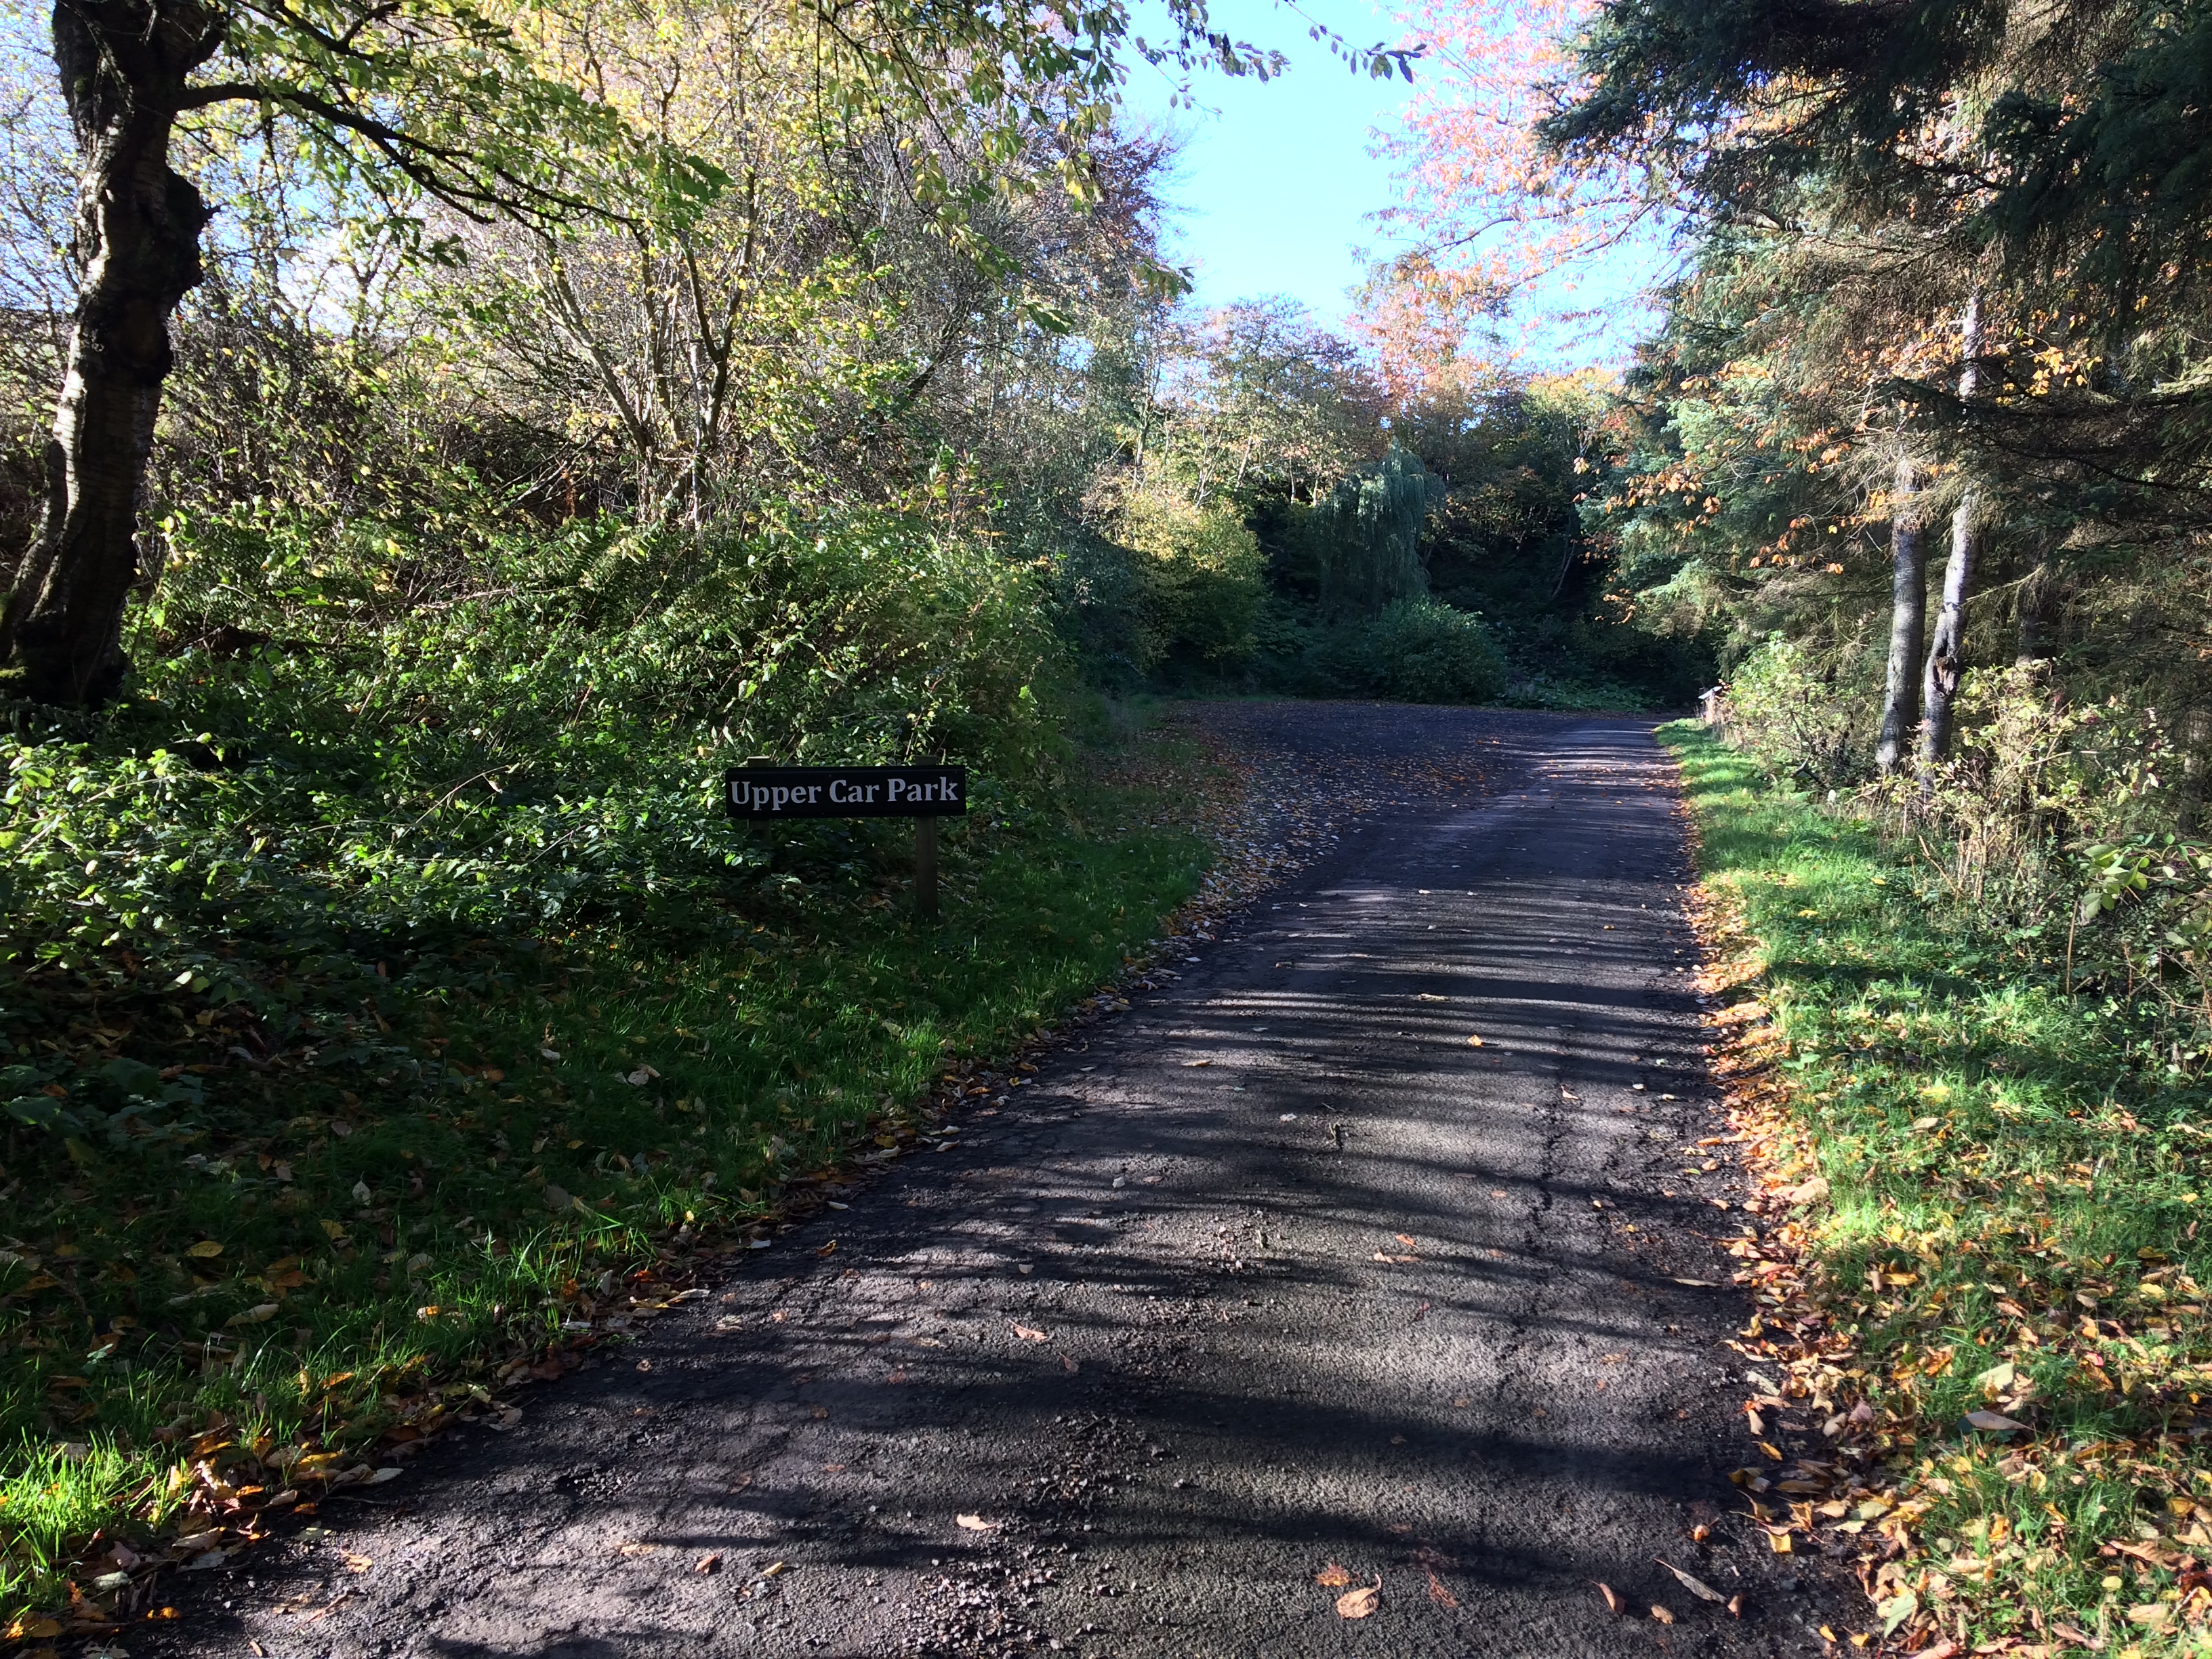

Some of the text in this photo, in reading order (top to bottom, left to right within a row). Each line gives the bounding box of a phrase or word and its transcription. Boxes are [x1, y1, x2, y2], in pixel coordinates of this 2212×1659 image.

[731, 777, 959, 811] Upper Car Park
